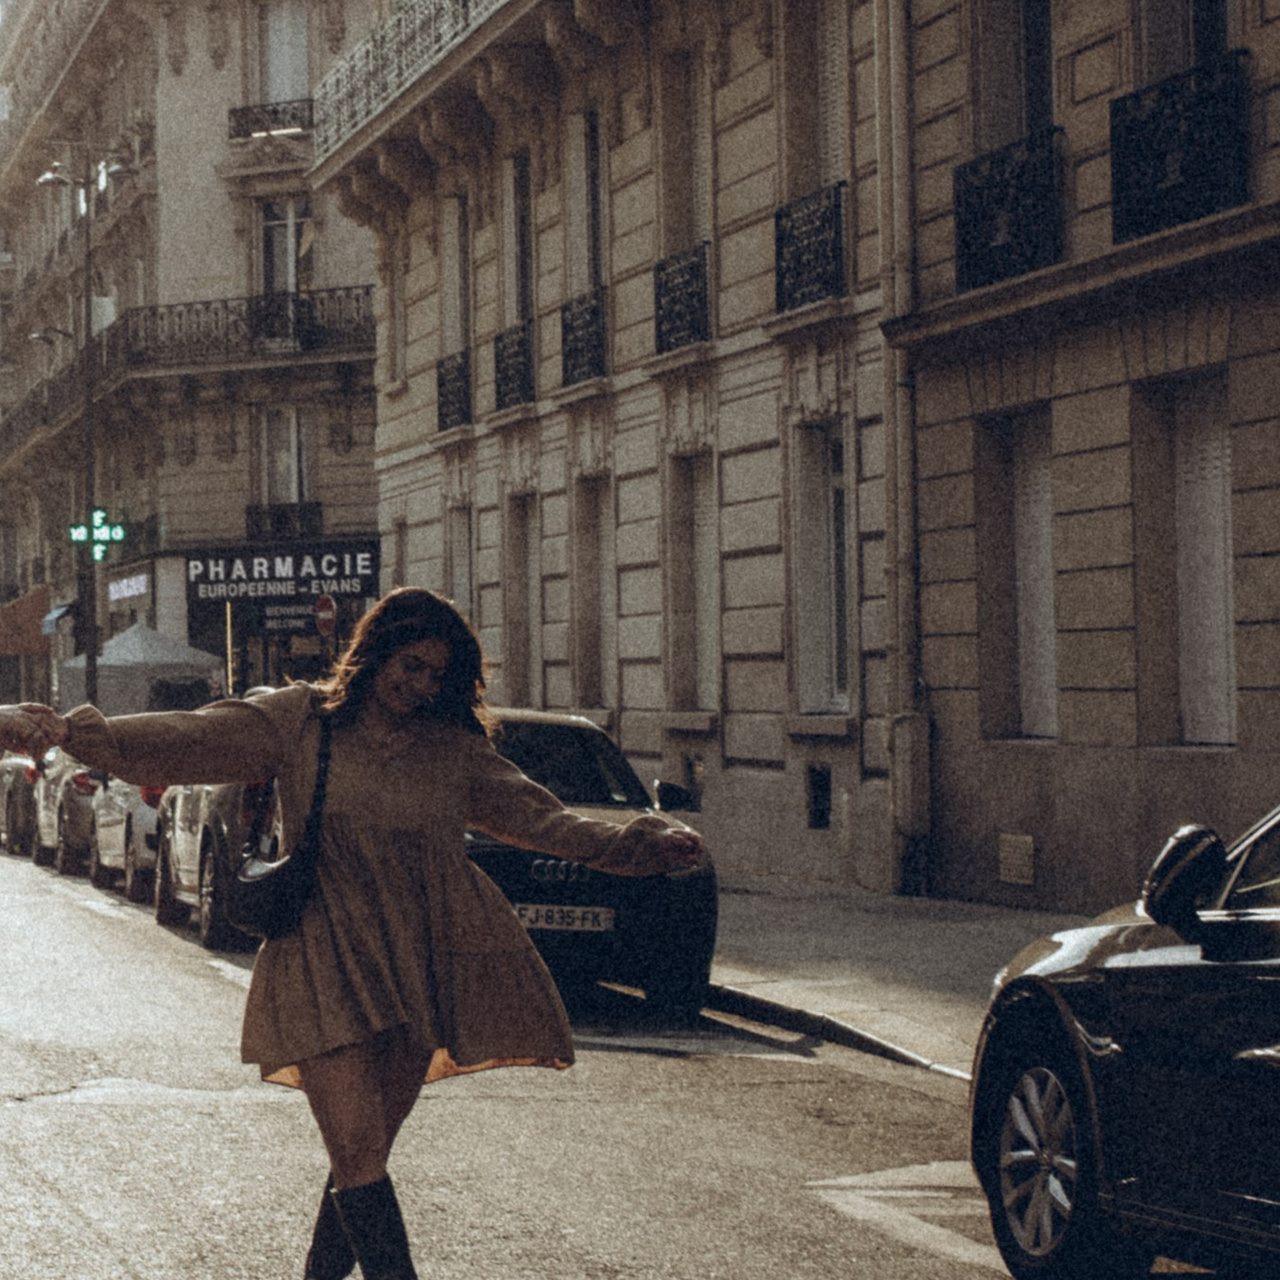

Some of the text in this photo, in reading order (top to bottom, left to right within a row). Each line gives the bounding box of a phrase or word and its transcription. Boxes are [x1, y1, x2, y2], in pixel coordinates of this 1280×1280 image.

[188, 552, 372, 582] PHARMACIE
[198, 581, 296, 598] EUROPEENNE
[311, 578, 362, 594] EVANS
